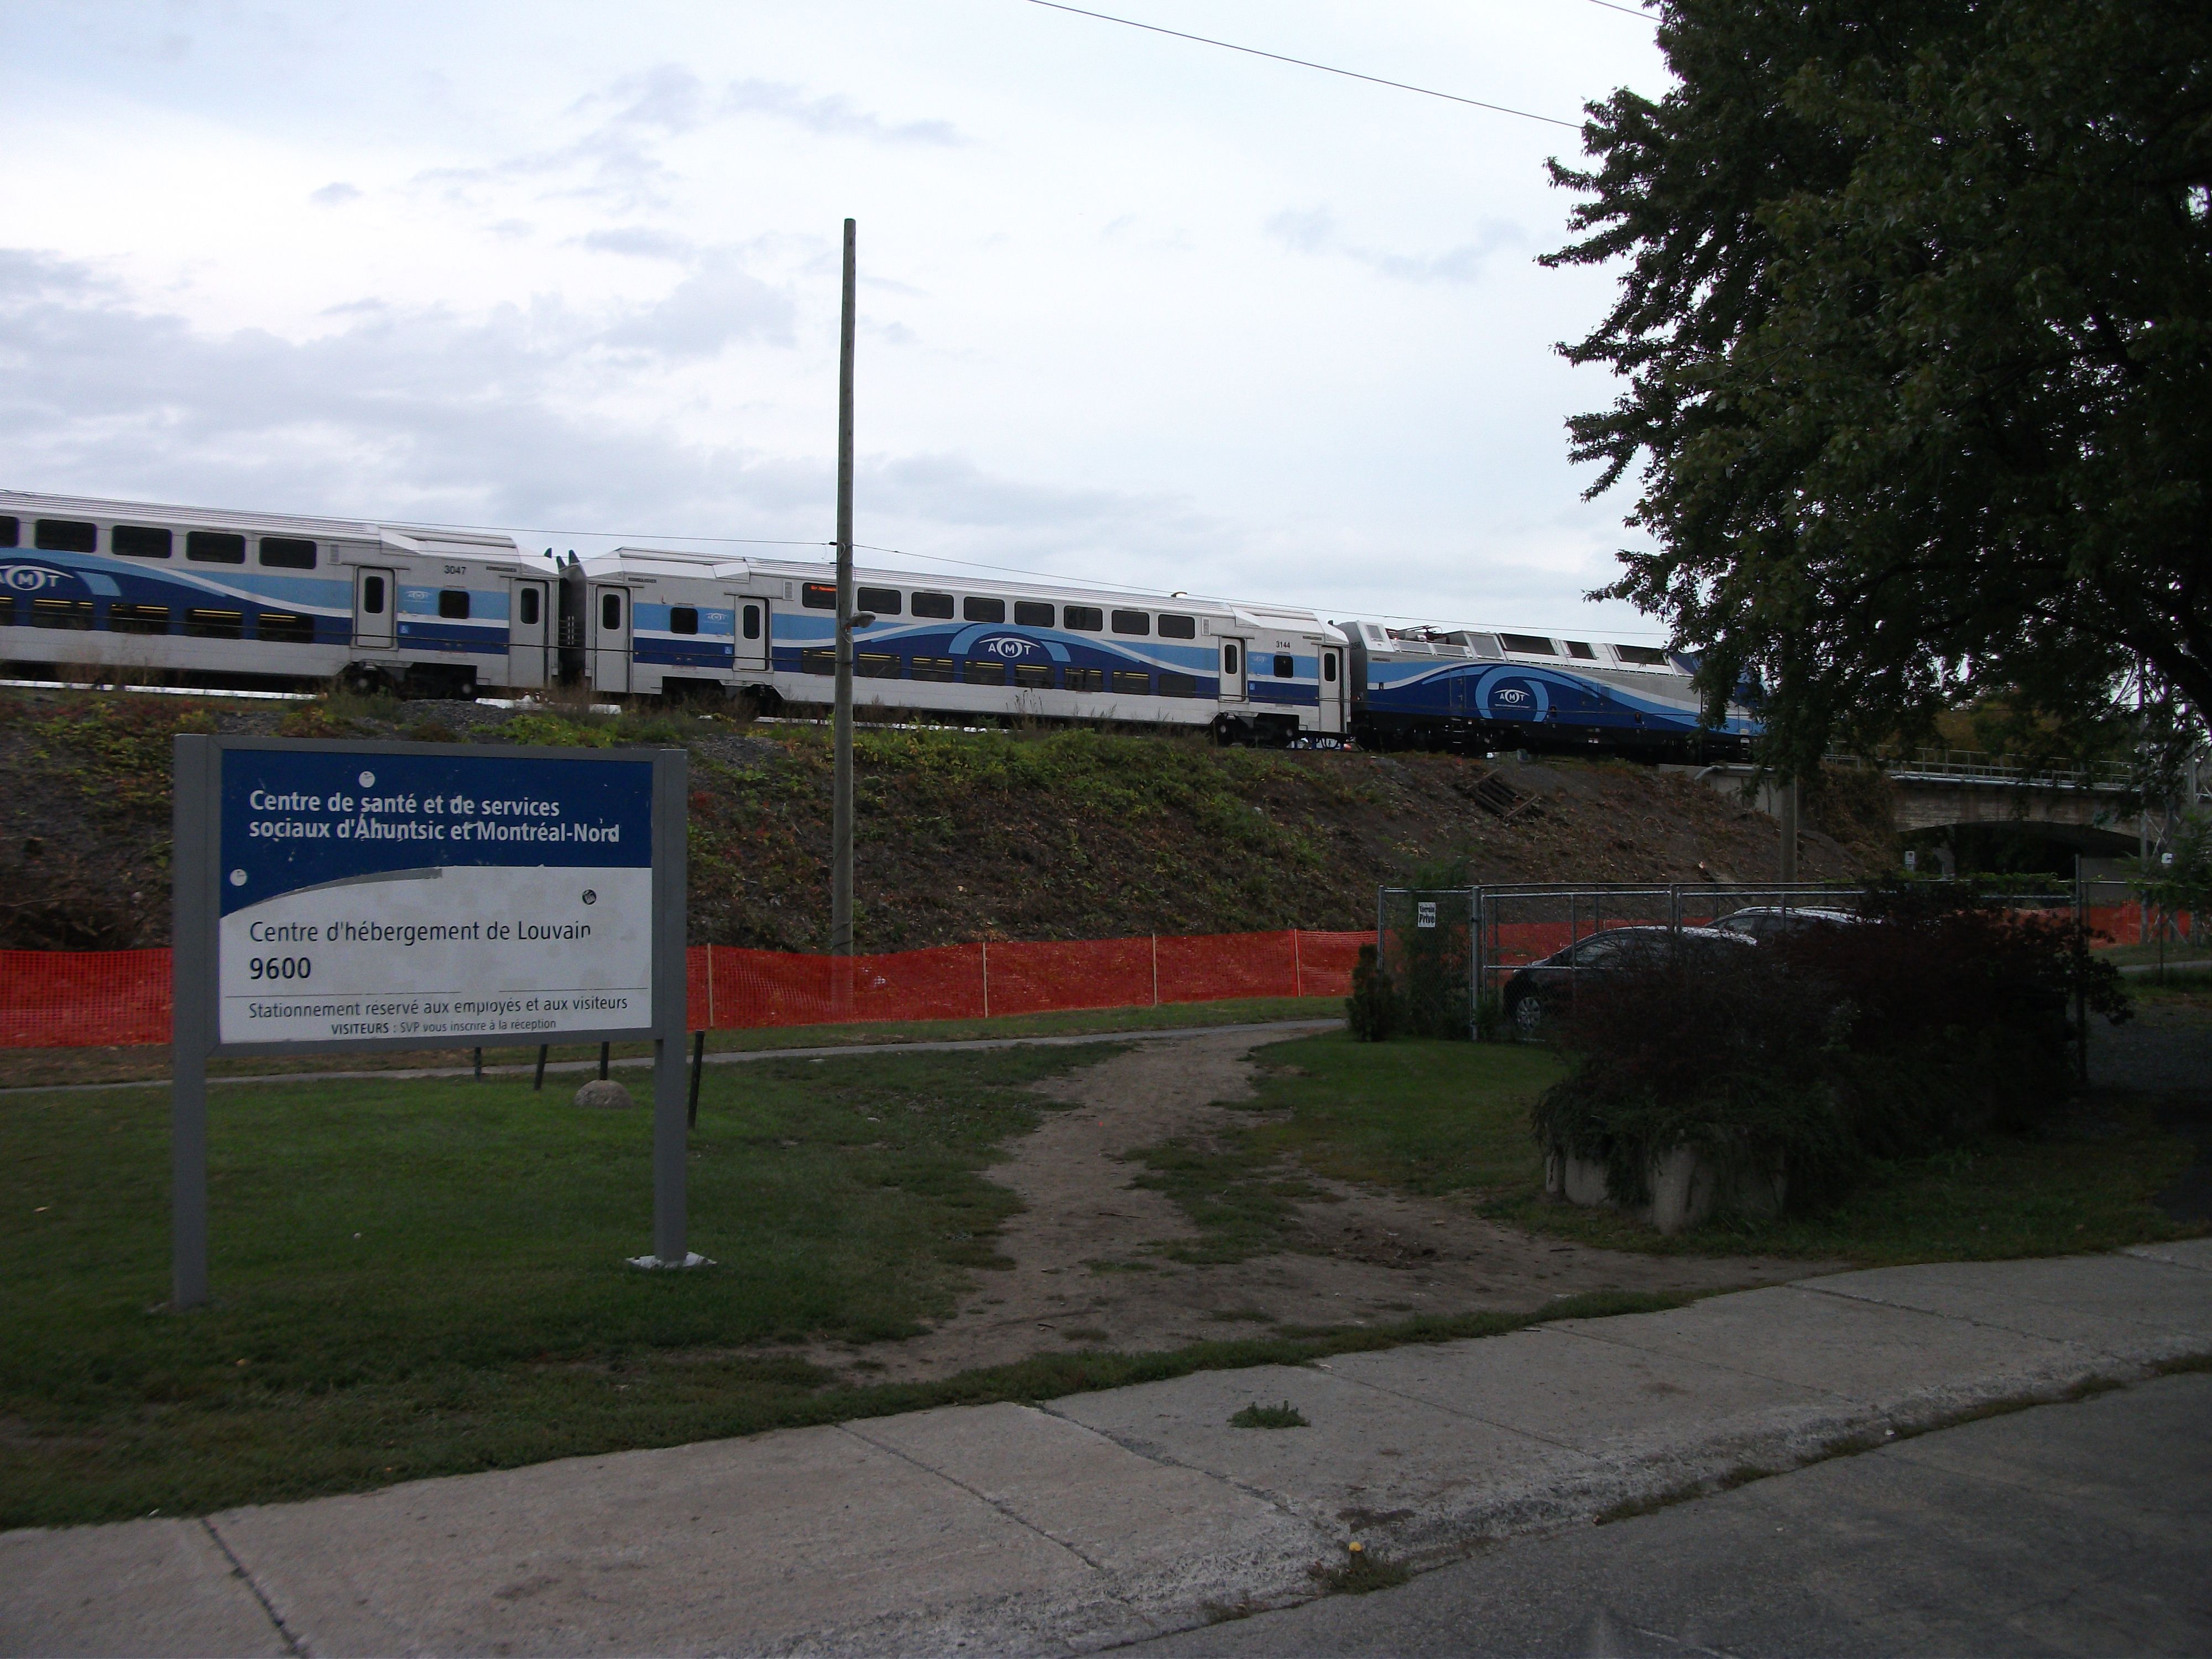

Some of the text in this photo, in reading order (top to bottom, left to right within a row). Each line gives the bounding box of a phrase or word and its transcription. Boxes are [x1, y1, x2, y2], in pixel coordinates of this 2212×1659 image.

[444, 565, 466, 575] 3047
[988, 641, 1031, 656] AMT
[1499, 691, 1525, 702] AMT
[249, 790, 560, 816] Centre de santé et de services
[249, 818, 331, 838] sociaux
[450, 822, 472, 841] et
[477, 822, 620, 842] Montréal-Nord
[250, 921, 591, 946] Centre d'hébergement de Louvain
[249, 957, 312, 979] 9600
[249, 995, 628, 1019] Stationnement réservé aux employés et aux visiteurs
[331, 1022, 389, 1035] VISITEURS
[400, 1022, 419, 1033] SVP
[423, 1023, 447, 1032] vous
[451, 1021, 486, 1031] inscrire
[489, 1019, 495, 1030] à
[499, 1019, 507, 1030] la
[511, 1018, 556, 1032] réception
